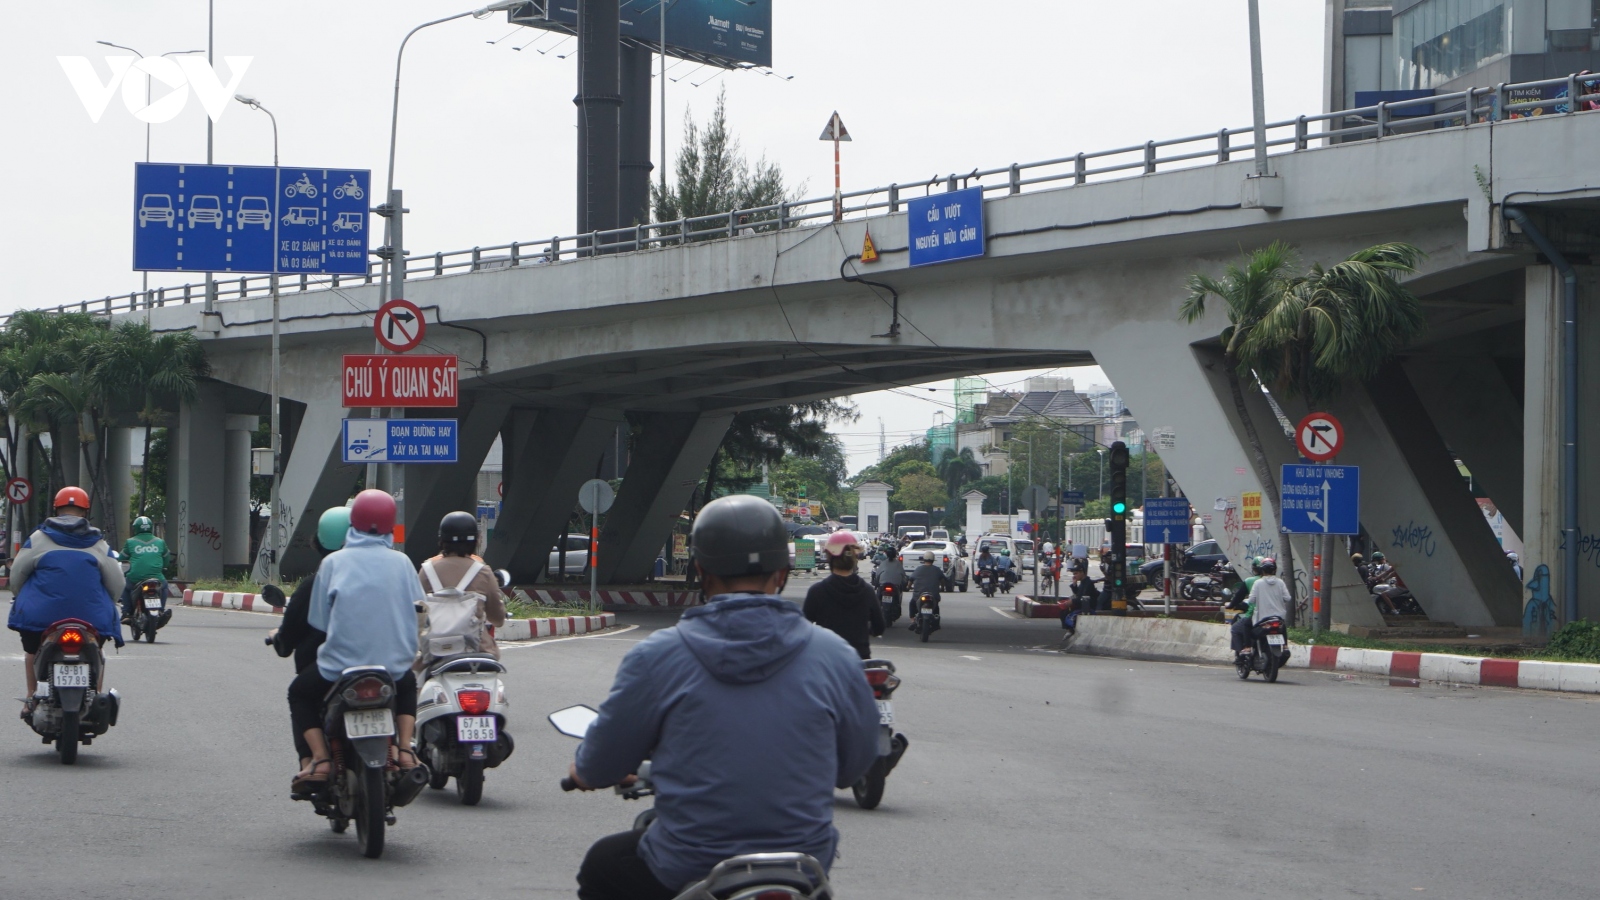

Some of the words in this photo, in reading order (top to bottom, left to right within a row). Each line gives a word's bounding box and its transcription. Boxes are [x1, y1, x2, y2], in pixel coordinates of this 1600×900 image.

[281, 240, 290, 252] XE
[292, 240, 300, 252] 02
[302, 238, 320, 252] BÁNH
[346, 238, 361, 246] BÁNH
[346, 250, 361, 258] BÁNH
[281, 254, 289, 268] VÀ
[291, 258, 300, 268] 03
[302, 256, 320, 269] BÁNH
[346, 359, 372, 398] CHÚ
[378, 359, 388, 398] Ý
[392, 366, 428, 398] QUAN
[432, 359, 456, 398] SÁT
[391, 426, 410, 438] ĐOẠN
[413, 424, 436, 437] ĐƯỜNG
[438, 426, 451, 437] HAY
[392, 442, 406, 455] XẢY
[408, 445, 418, 455] RA
[421, 445, 431, 455] TAI
[434, 445, 448, 457] NẠN
[1296, 468, 1304, 478] KHU
[1324, 468, 1344, 479] VINHOMES
[134, 544, 159, 554] Grab
[59, 665, 83, 675] 49-B1
[56, 676, 87, 686] 157.89
[354, 722, 387, 735] 1752
[460, 729, 494, 740] 138.58
